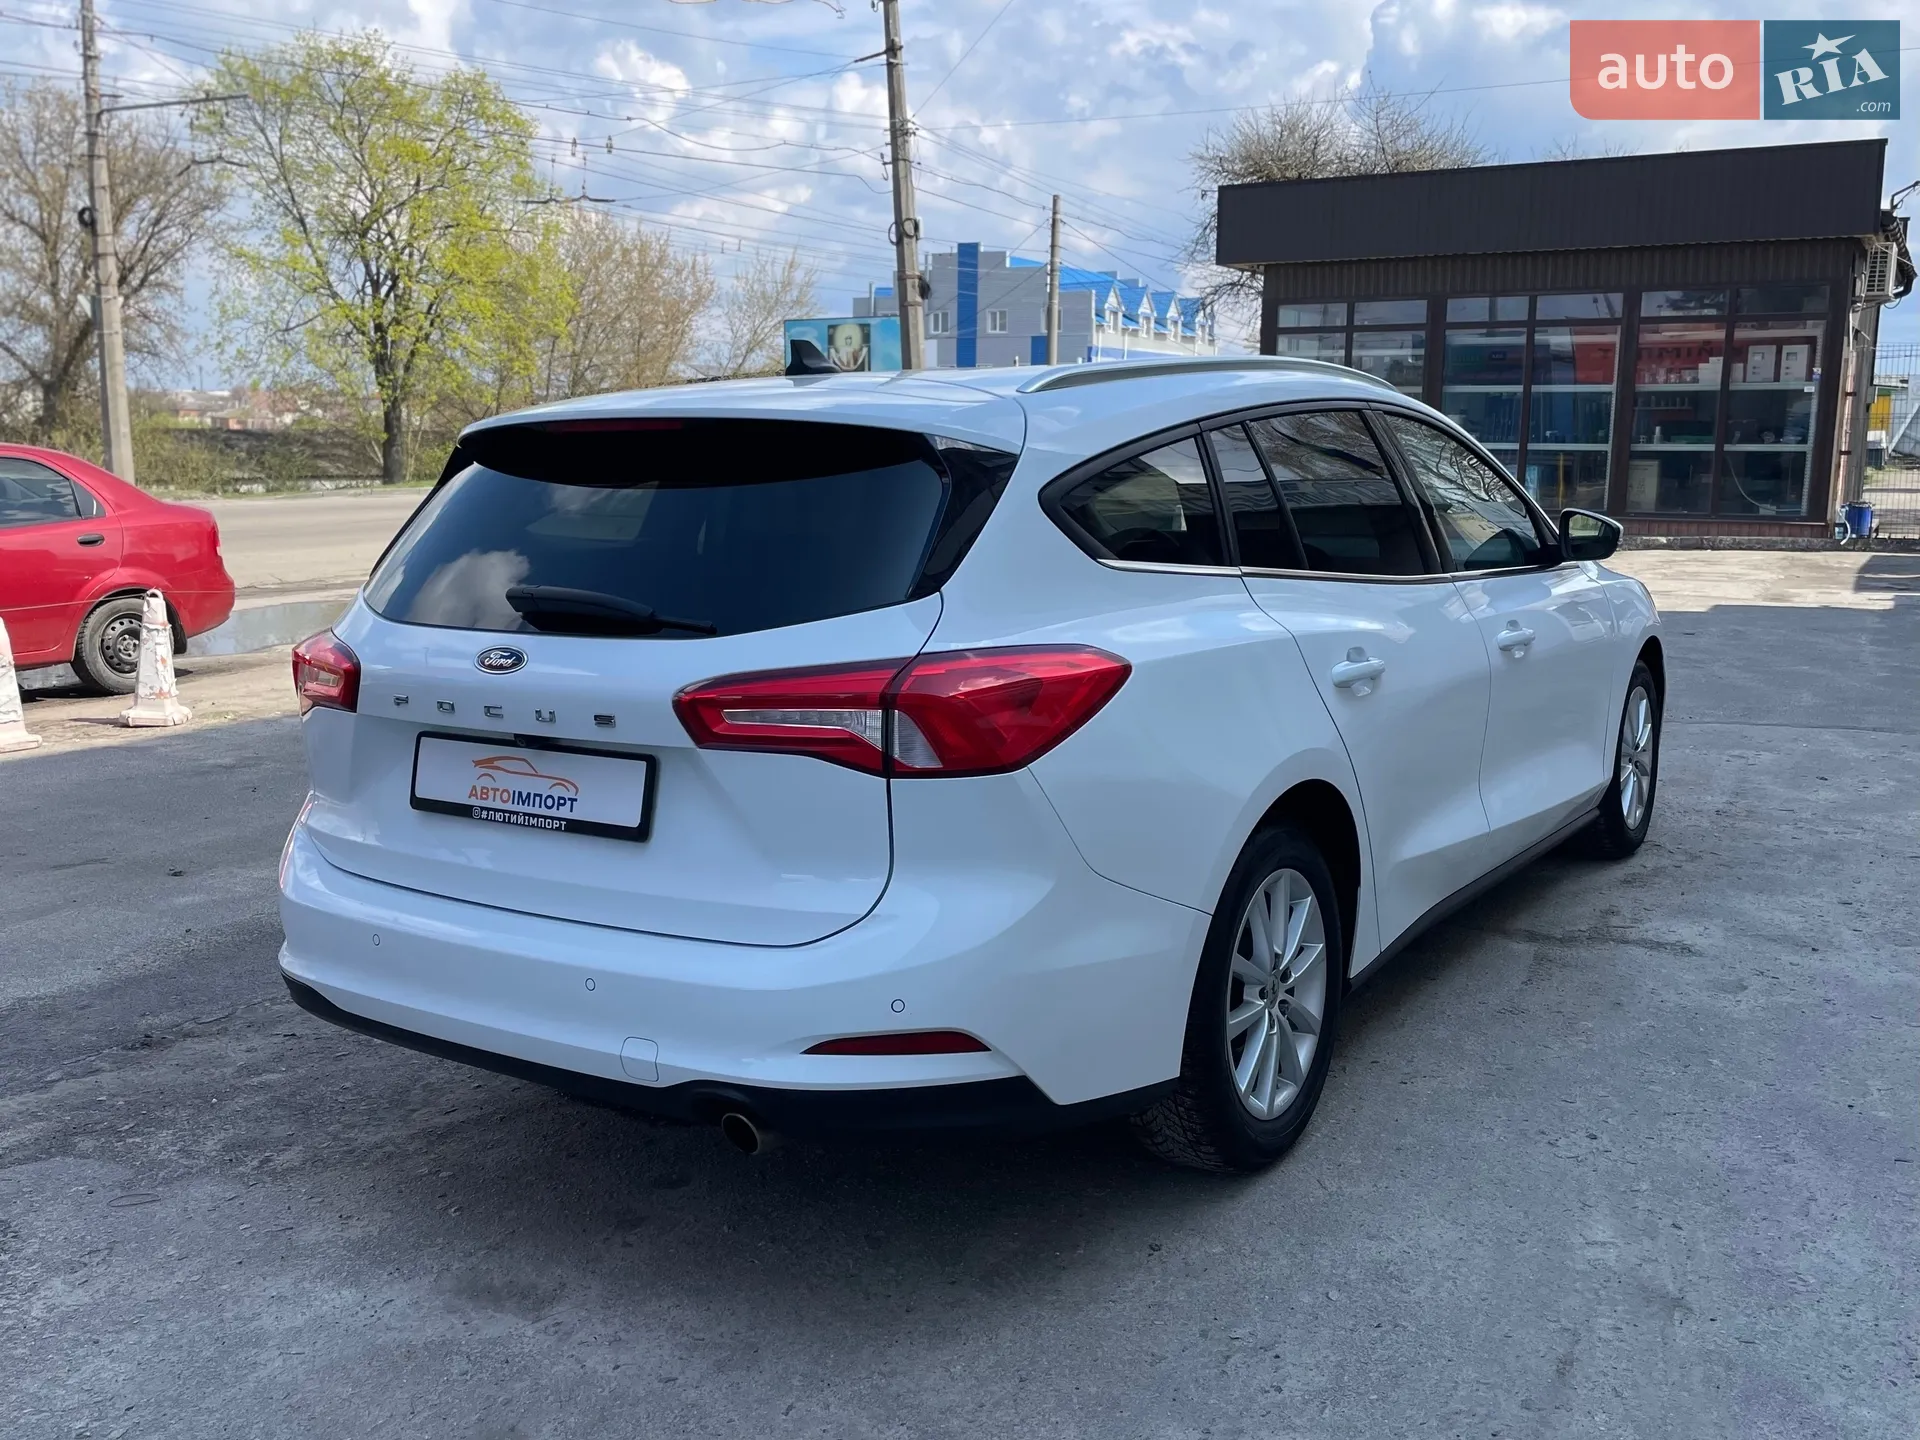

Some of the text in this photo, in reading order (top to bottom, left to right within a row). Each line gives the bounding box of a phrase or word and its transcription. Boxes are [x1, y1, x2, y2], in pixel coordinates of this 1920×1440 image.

[484, 651, 516, 667] Ford
[393, 694, 616, 727] FOCUS
[468, 784, 578, 813] АВТОІМПОРТ
